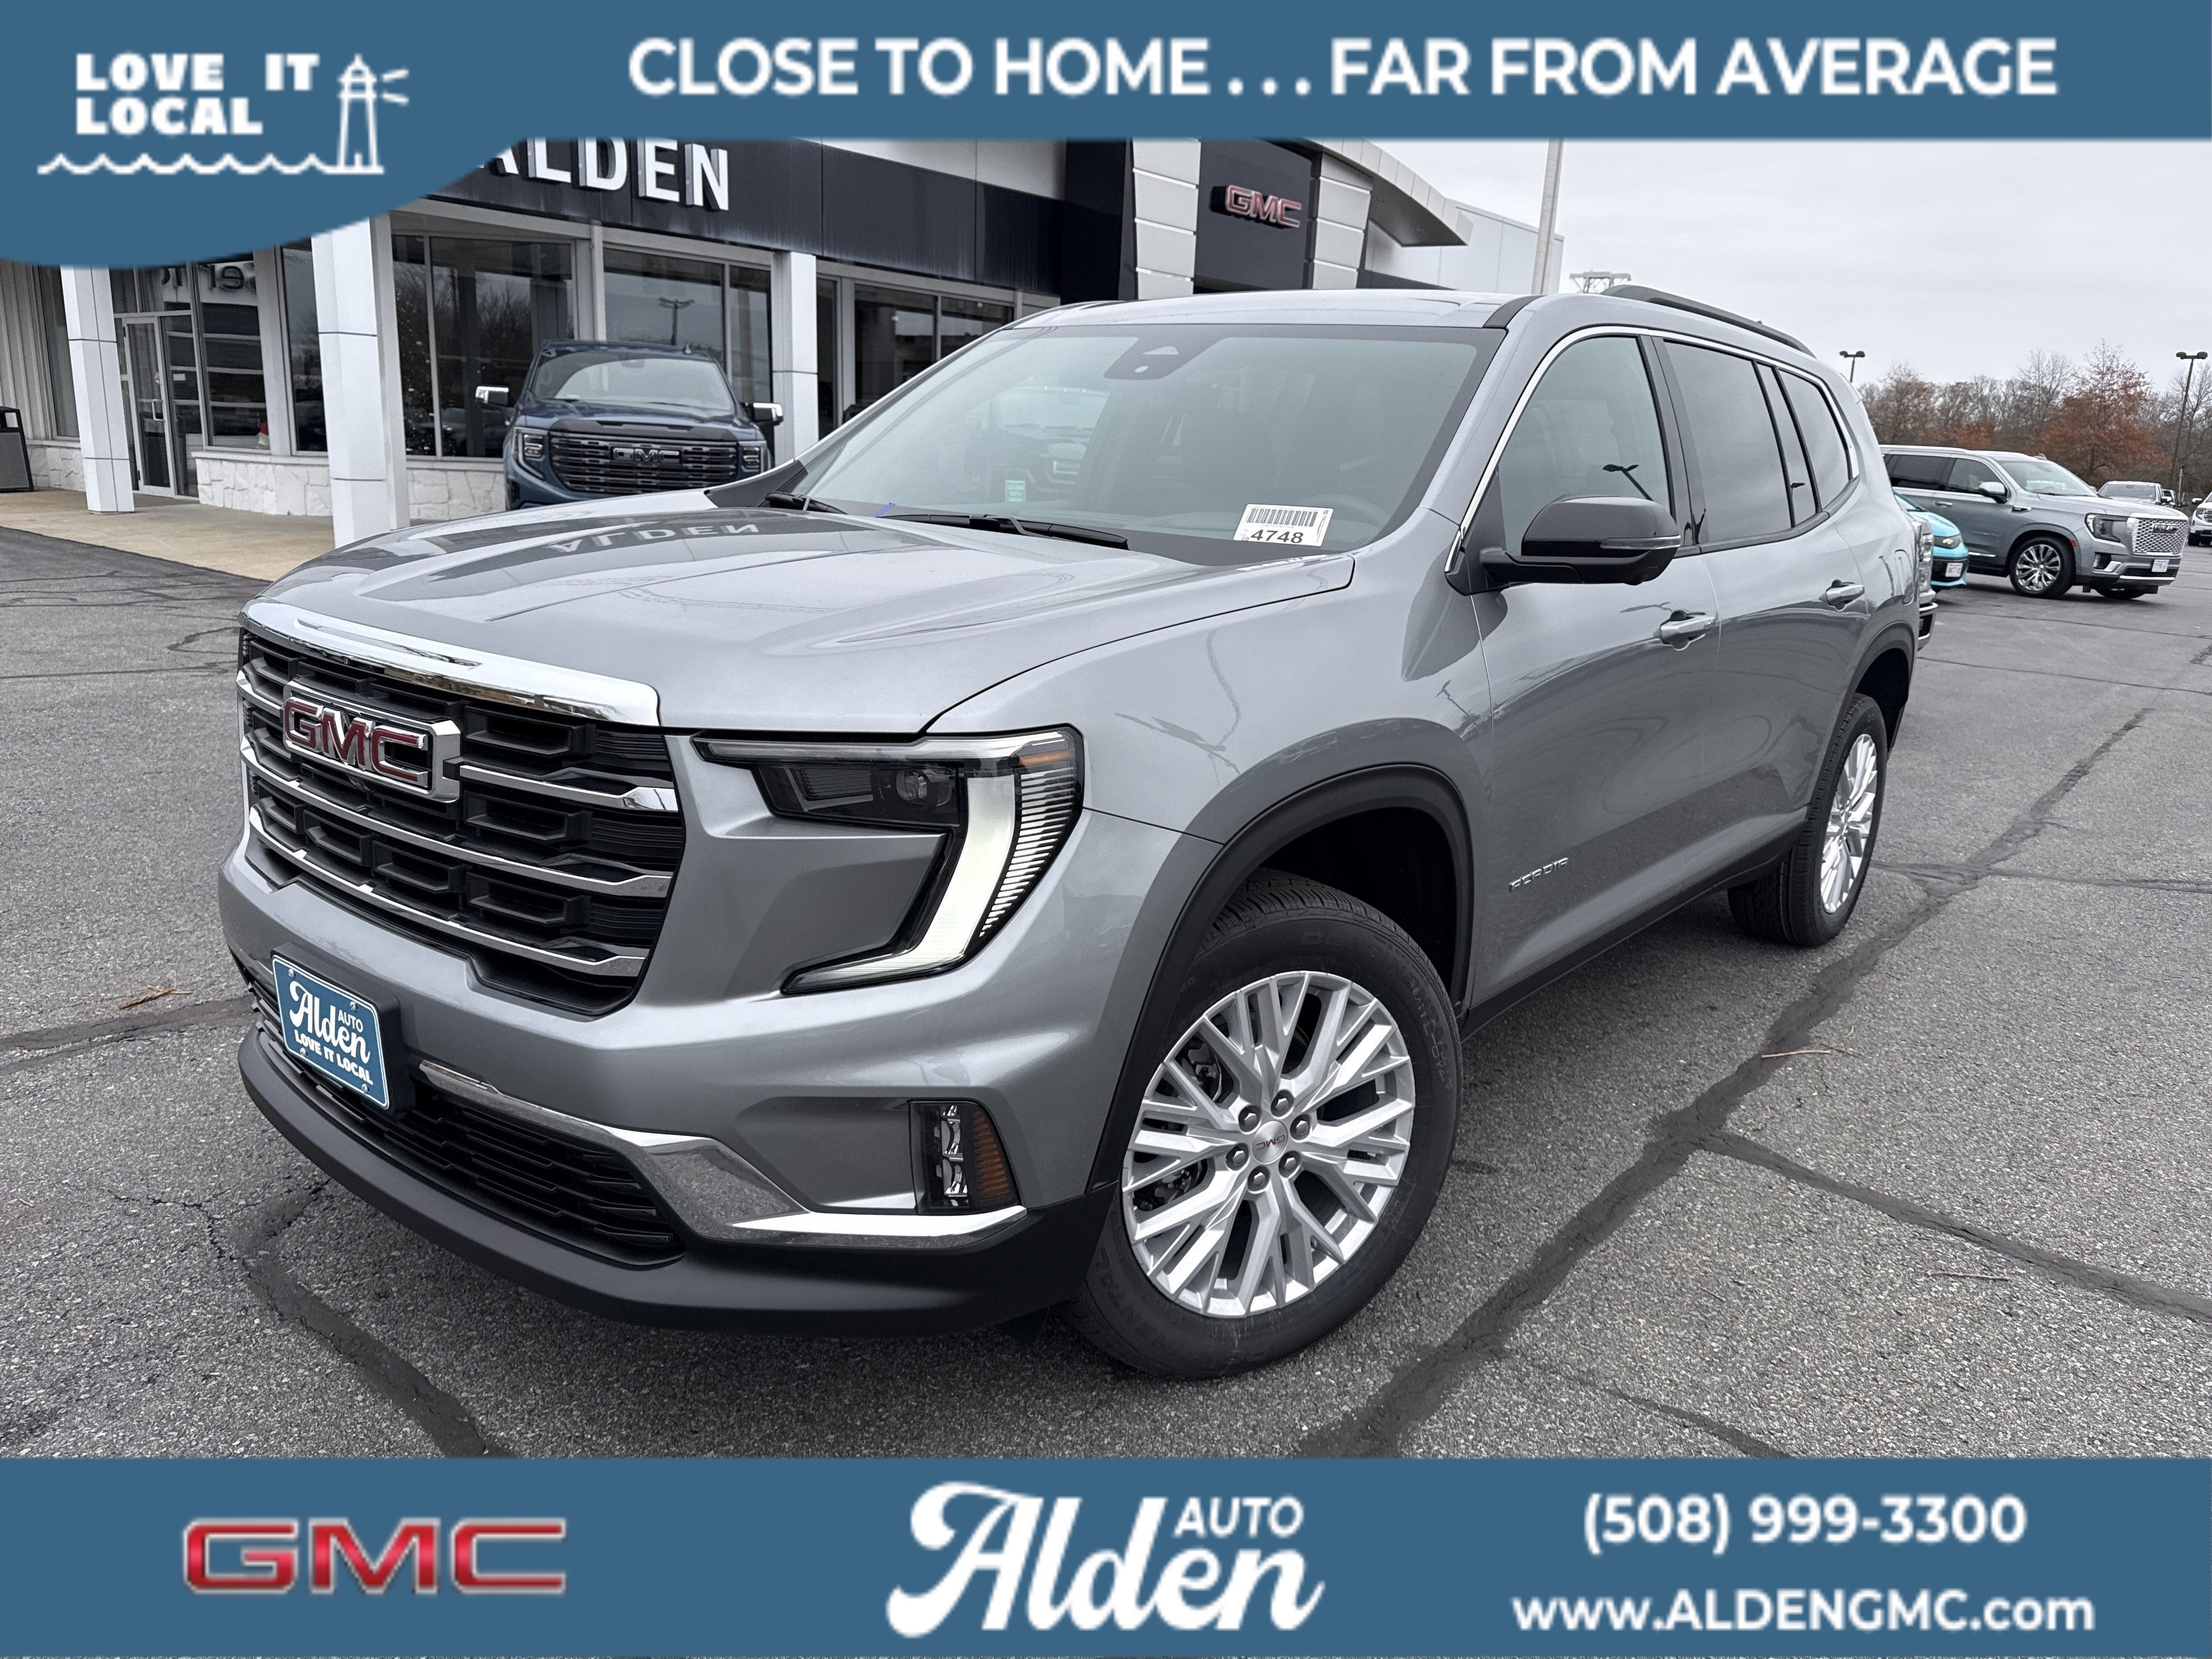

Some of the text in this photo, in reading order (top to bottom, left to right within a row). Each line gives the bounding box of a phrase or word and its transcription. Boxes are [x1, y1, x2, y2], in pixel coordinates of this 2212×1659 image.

[1226, 185, 1302, 228] GMC
[613, 448, 680, 463] GMC
[1250, 529, 1304, 544] 4748
[283, 696, 428, 788] GMC
[289, 980, 371, 1064] Alden
[338, 1009, 363, 1033] AUTO
[294, 1029, 374, 1086] LOVE IT LOCAL
[1256, 1134, 1285, 1150] GMC
